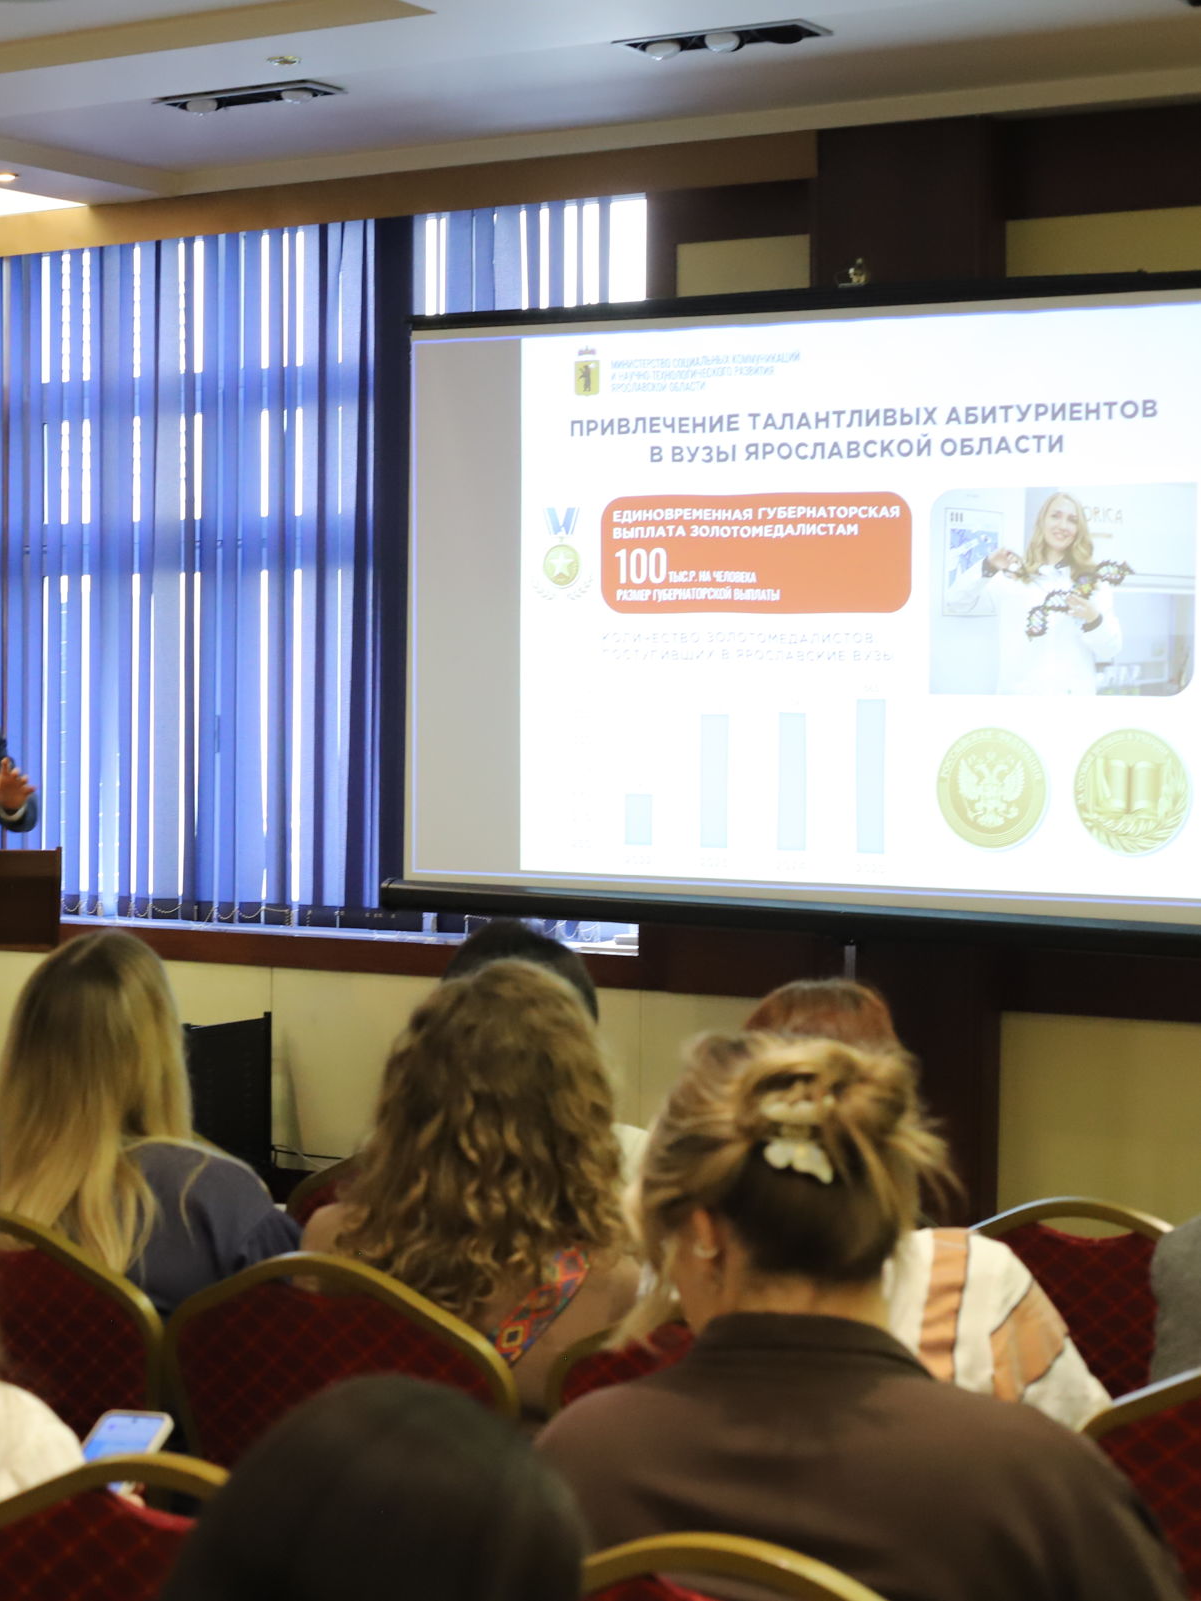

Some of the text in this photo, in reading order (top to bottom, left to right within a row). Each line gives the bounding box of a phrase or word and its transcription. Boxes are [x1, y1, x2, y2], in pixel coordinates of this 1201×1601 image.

[570, 399, 1158, 437] ПРИВЛЕЧЕНИЕ ТАЛАНТЛИВЫХ АБИТУРИЕНТОВ
[649, 433, 1064, 464] В ВУЗЫ ЯРОСЛАВСКОЙ ОБЛАСТИ
[612, 505, 901, 524] ЕДИНОВРЕМЕННАЯ ГУБЕРНАТОРСКАЯ
[612, 523, 859, 540] ВЫПЛАТА ЗОЛОТОМЕДАЛИСТАМ
[614, 547, 668, 585] 100
[699, 570, 711, 583] НА
[712, 570, 757, 583] ЧЕЛОВЕКА
[616, 586, 781, 602] РАЗМЕР ГУБЕРНАТОРСКОЙ ВЫПЛАТЫ
